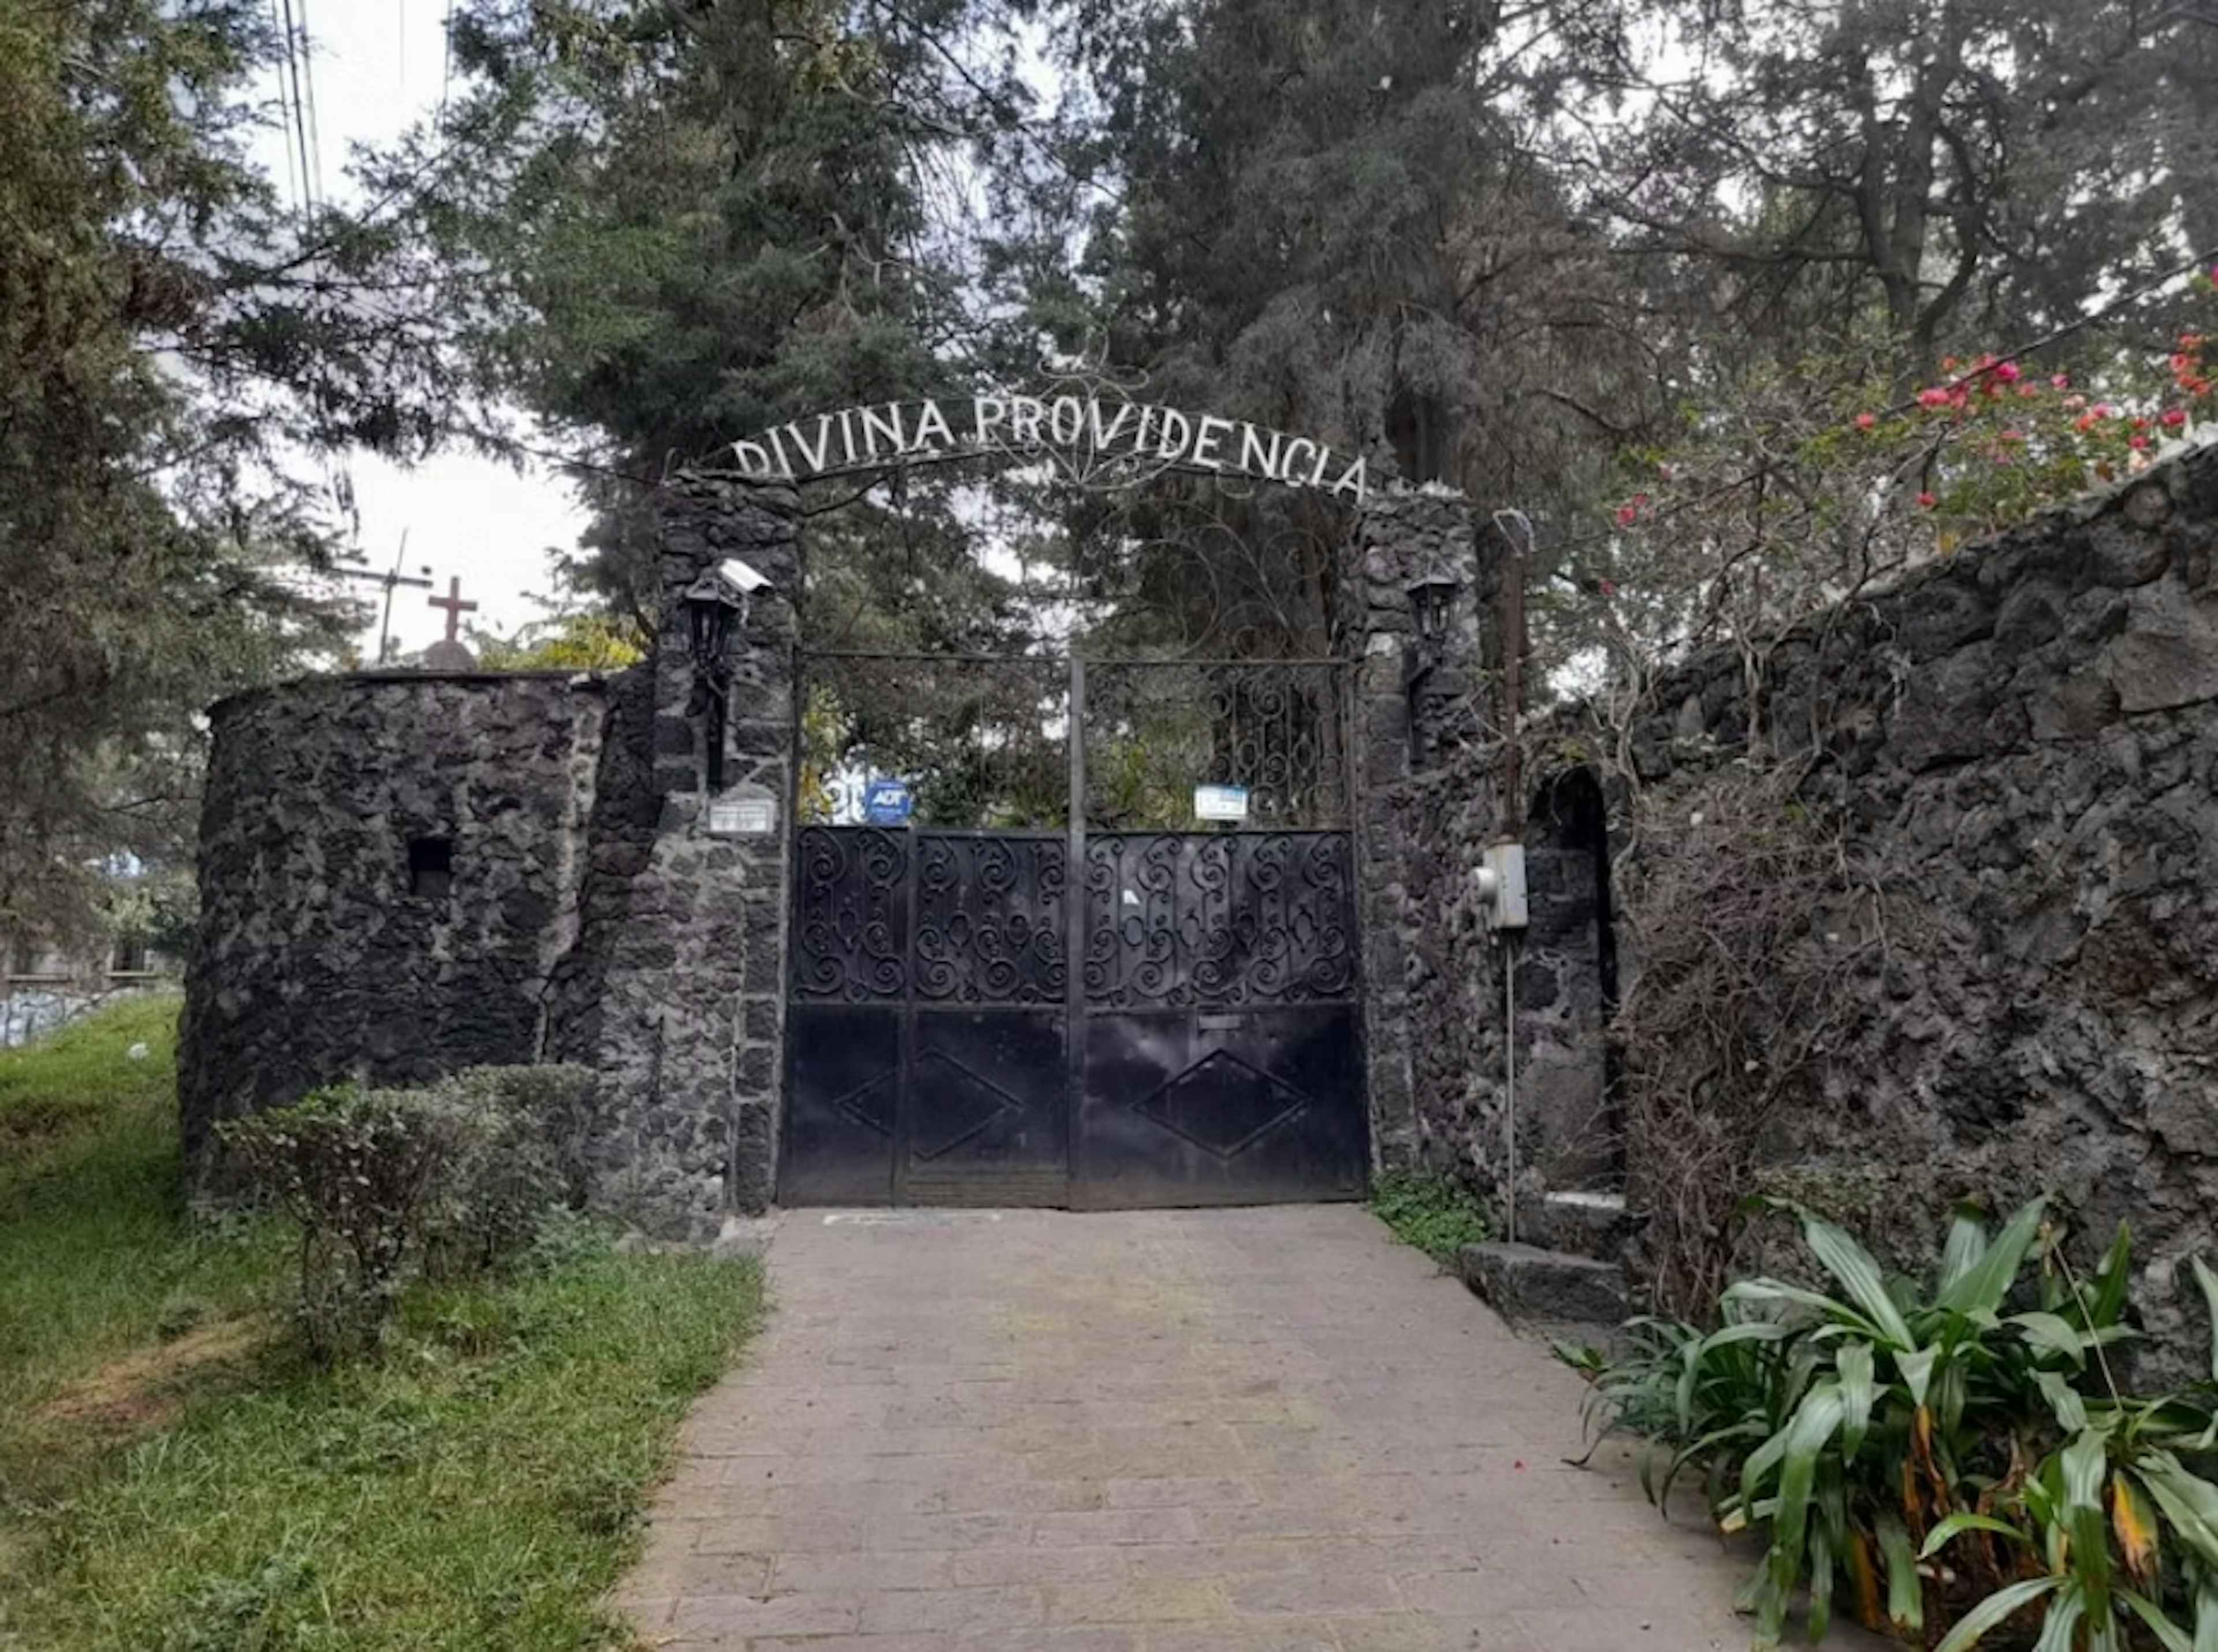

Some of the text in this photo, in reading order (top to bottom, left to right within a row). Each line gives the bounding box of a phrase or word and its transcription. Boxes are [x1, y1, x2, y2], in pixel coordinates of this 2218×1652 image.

[730, 395, 1371, 504] DIVINA PROVIDENCIA
[872, 789, 907, 806] ADT
